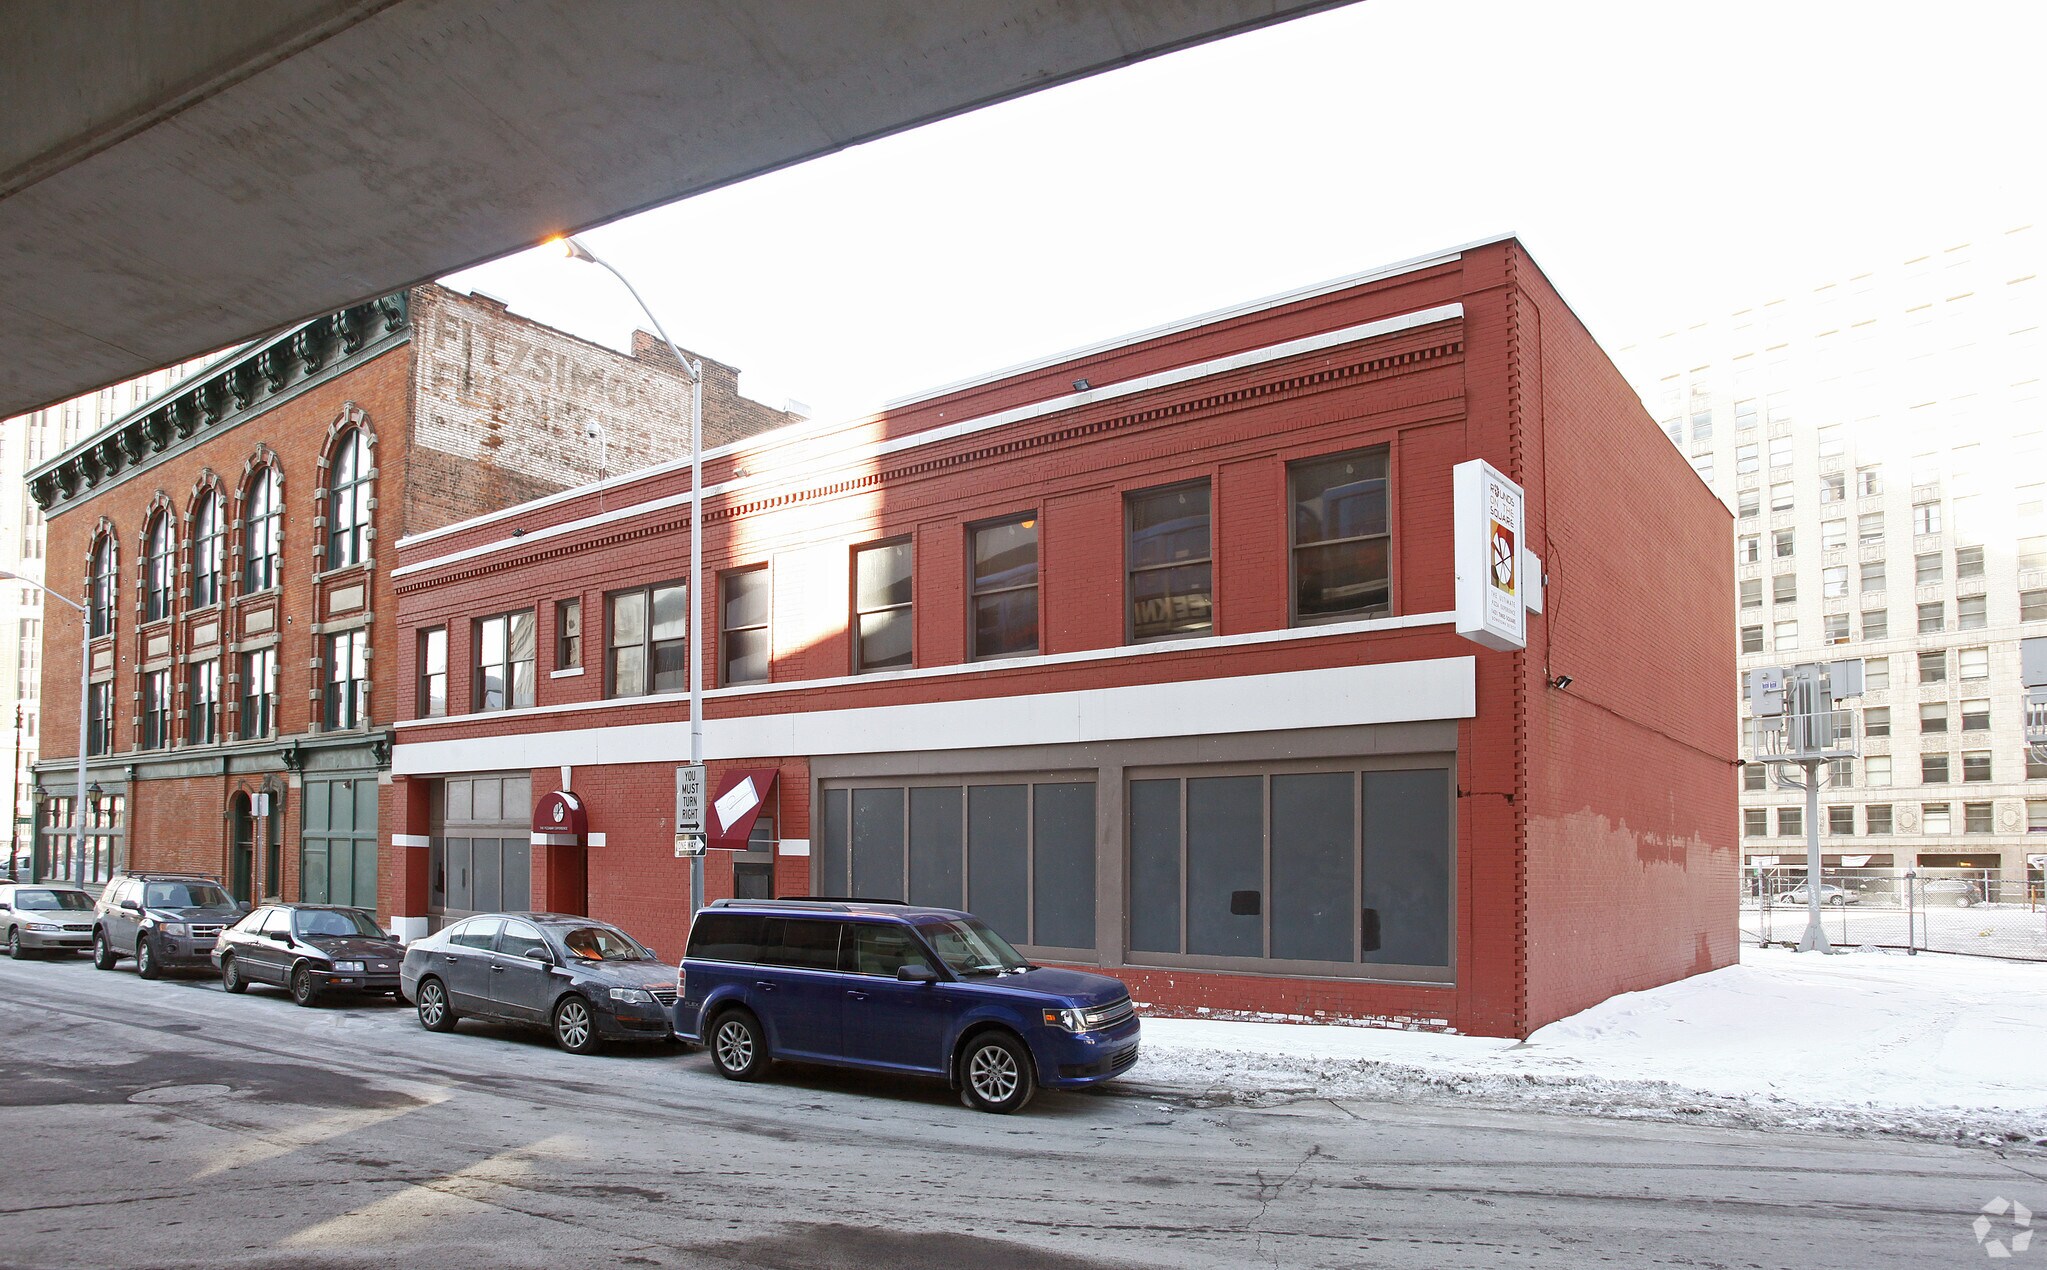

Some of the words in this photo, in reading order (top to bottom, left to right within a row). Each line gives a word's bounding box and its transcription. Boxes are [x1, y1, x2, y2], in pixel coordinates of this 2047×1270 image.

[1490, 482, 1515, 507] ROUNDS
[1489, 494, 1499, 508] ON
[1502, 502, 1515, 519] THE
[1489, 504, 1515, 529] SQUARE
[684, 770, 696, 781] YOU
[681, 782, 699, 794] MUST
[683, 796, 698, 807] TURN
[681, 808, 698, 820] RIGHT
[677, 841, 687, 850] ONE
[687, 840, 697, 850] WAY
